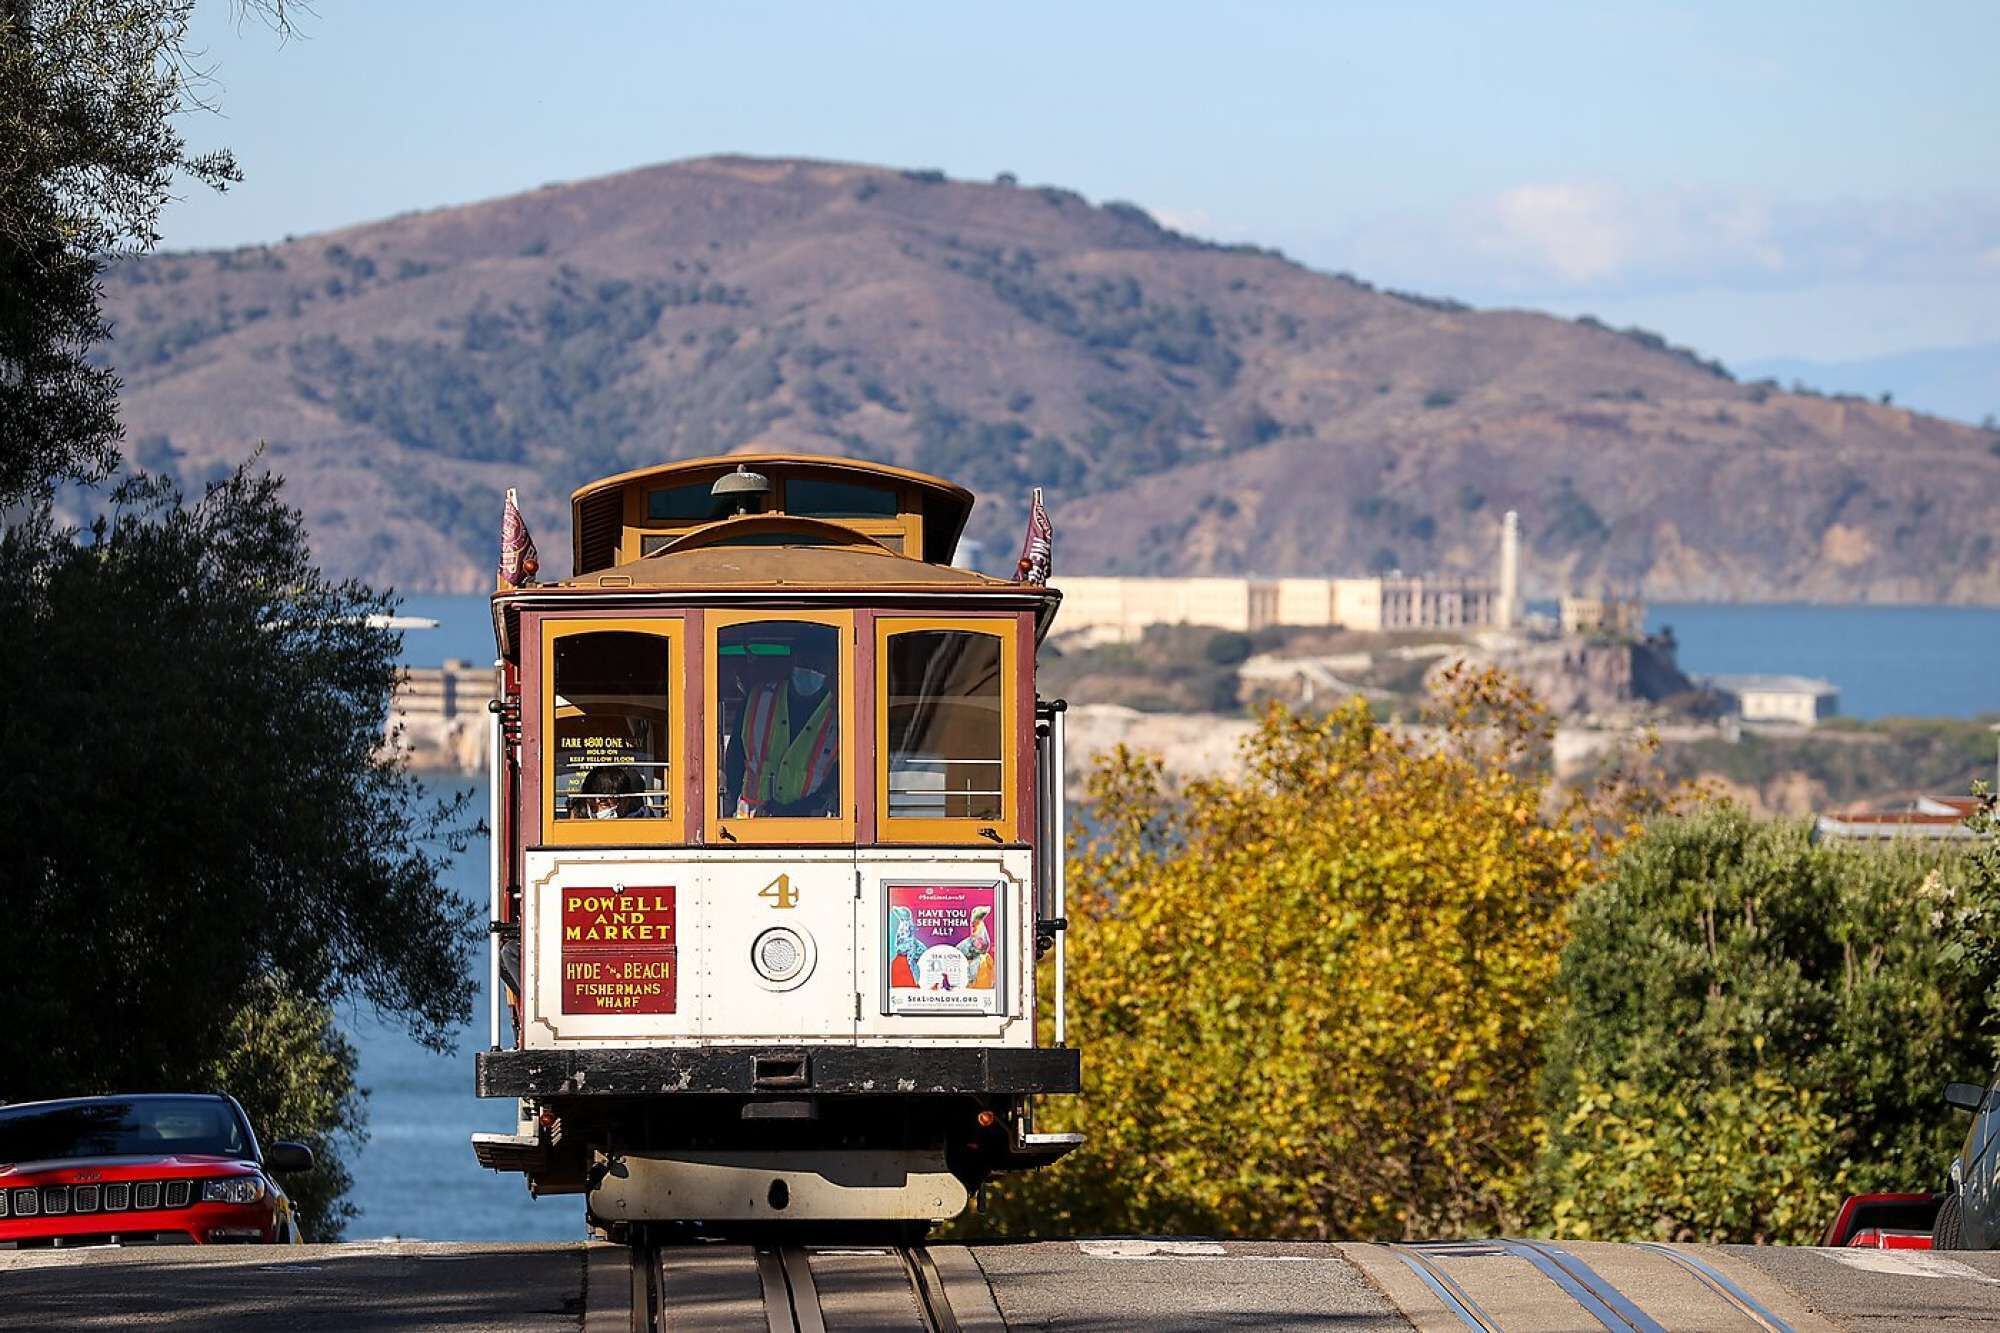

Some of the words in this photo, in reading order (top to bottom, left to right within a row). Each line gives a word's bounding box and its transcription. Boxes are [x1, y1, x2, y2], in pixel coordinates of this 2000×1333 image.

[605, 738, 624, 748] ONE
[757, 872, 800, 909] 4
[568, 896, 668, 912] POWELL
[594, 912, 645, 924] AND
[918, 909, 944, 918] HAVE
[945, 909, 967, 918] YOU
[916, 918, 941, 927] SEEN
[942, 918, 969, 927] THEM
[566, 925, 671, 940] MARKET
[932, 927, 954, 936] ALL?
[566, 962, 601, 979] HYDE
[623, 962, 670, 979] BEACH
[575, 983, 661, 996] FISHERMANS
[596, 996, 640, 1008] WHARF
